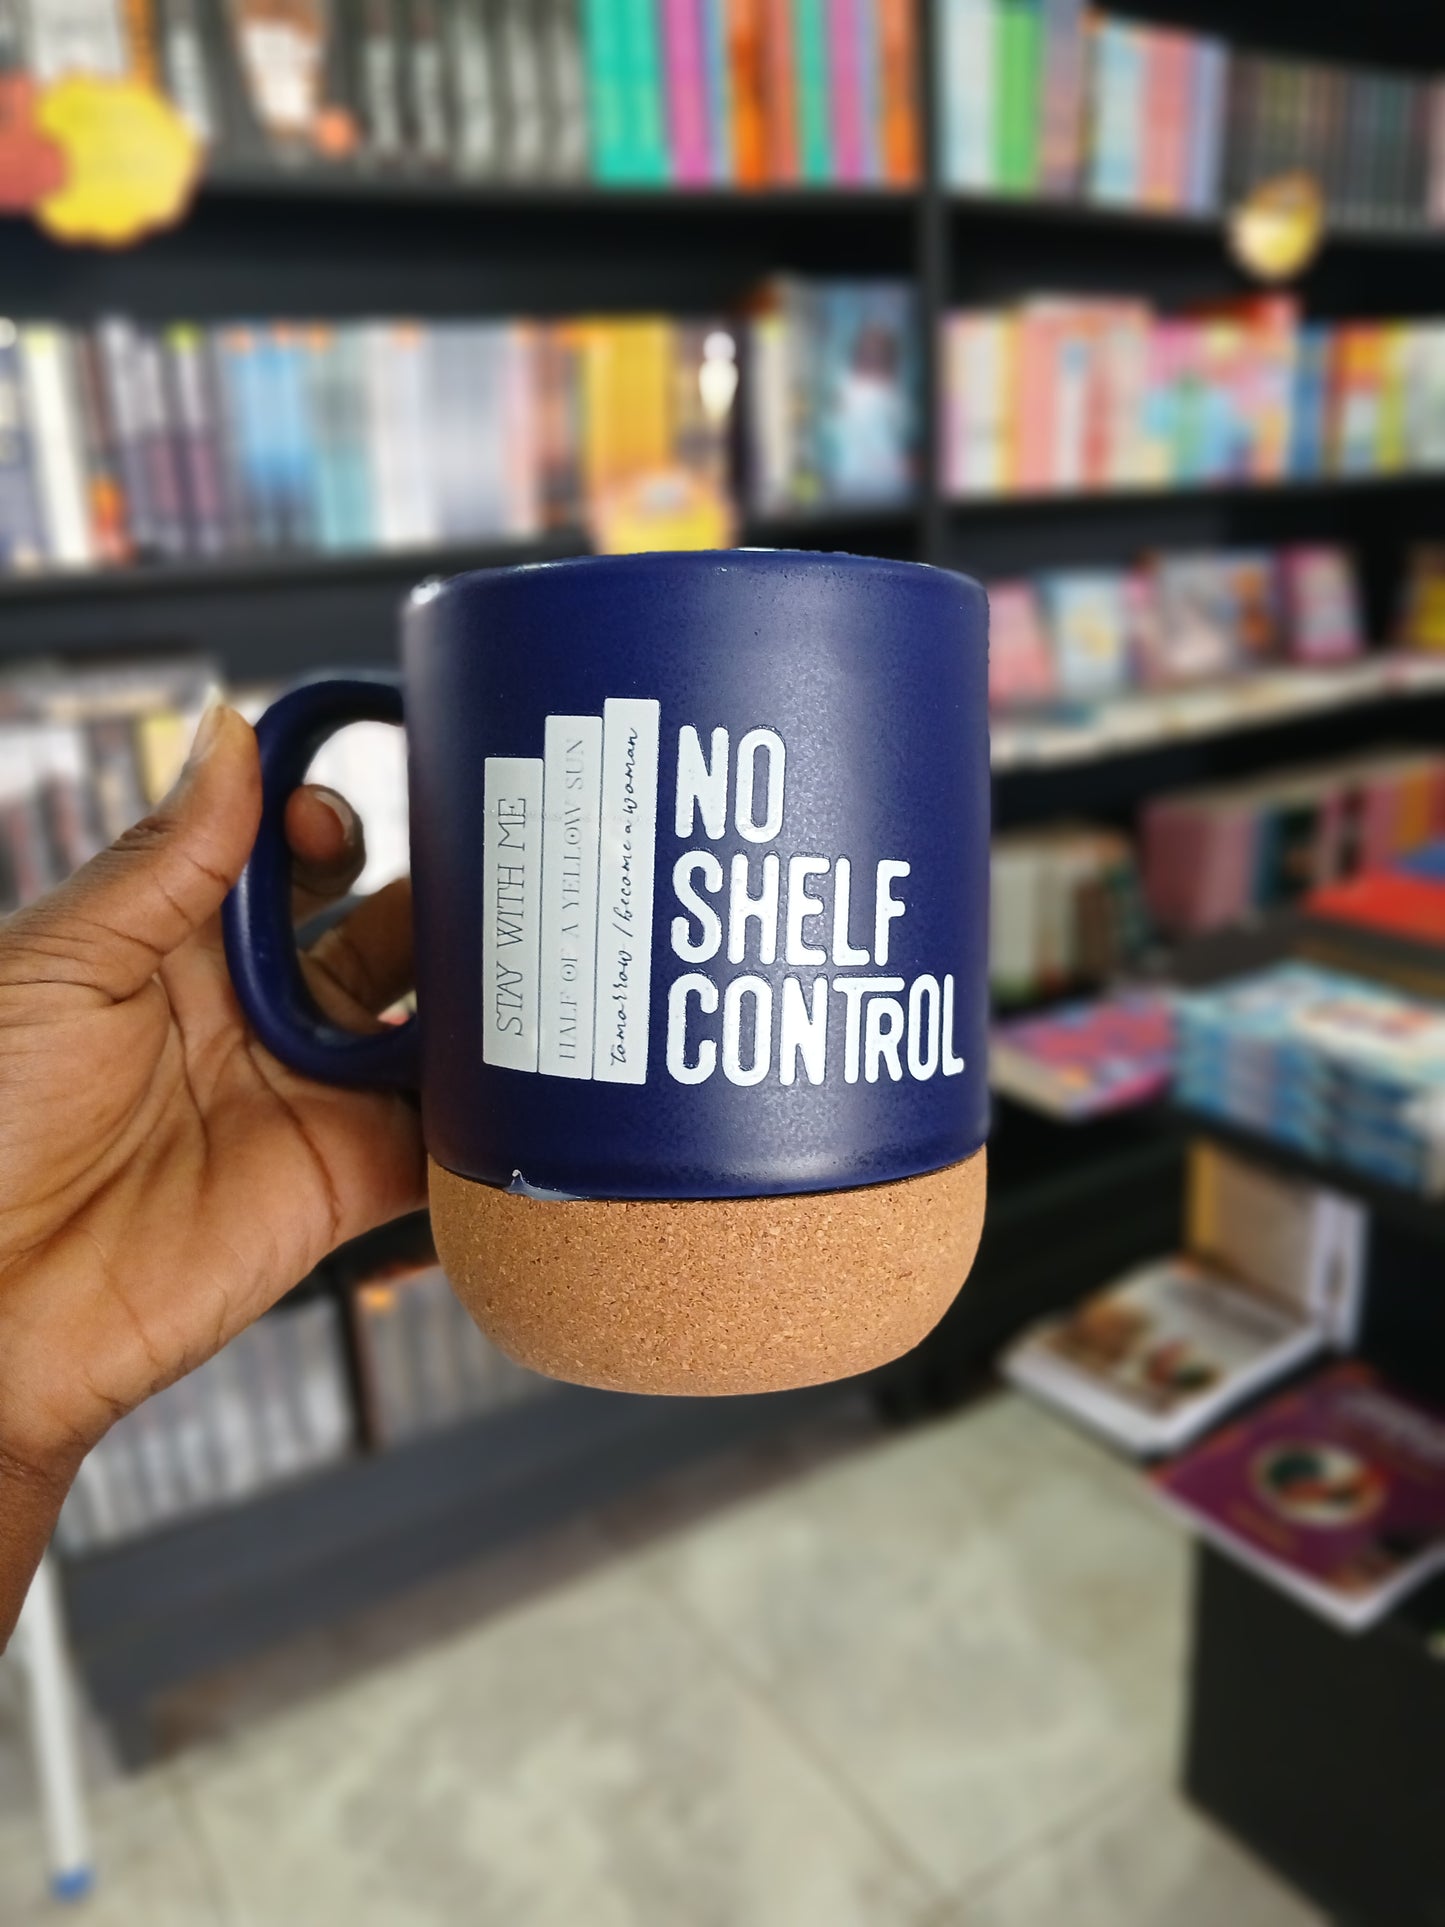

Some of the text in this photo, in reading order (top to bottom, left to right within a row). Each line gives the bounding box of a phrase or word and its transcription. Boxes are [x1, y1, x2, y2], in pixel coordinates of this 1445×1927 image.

[622, 727, 638, 815] woman
[625, 822, 634, 834] a
[675, 725, 786, 843] NO
[496, 798, 526, 1037] STAY WITH ME
[559, 739, 583, 1060] HALF OF A YELLOW SUN
[612, 841, 634, 922] become
[671, 850, 911, 965] SHELF
[666, 972, 965, 1087] CONTROL
